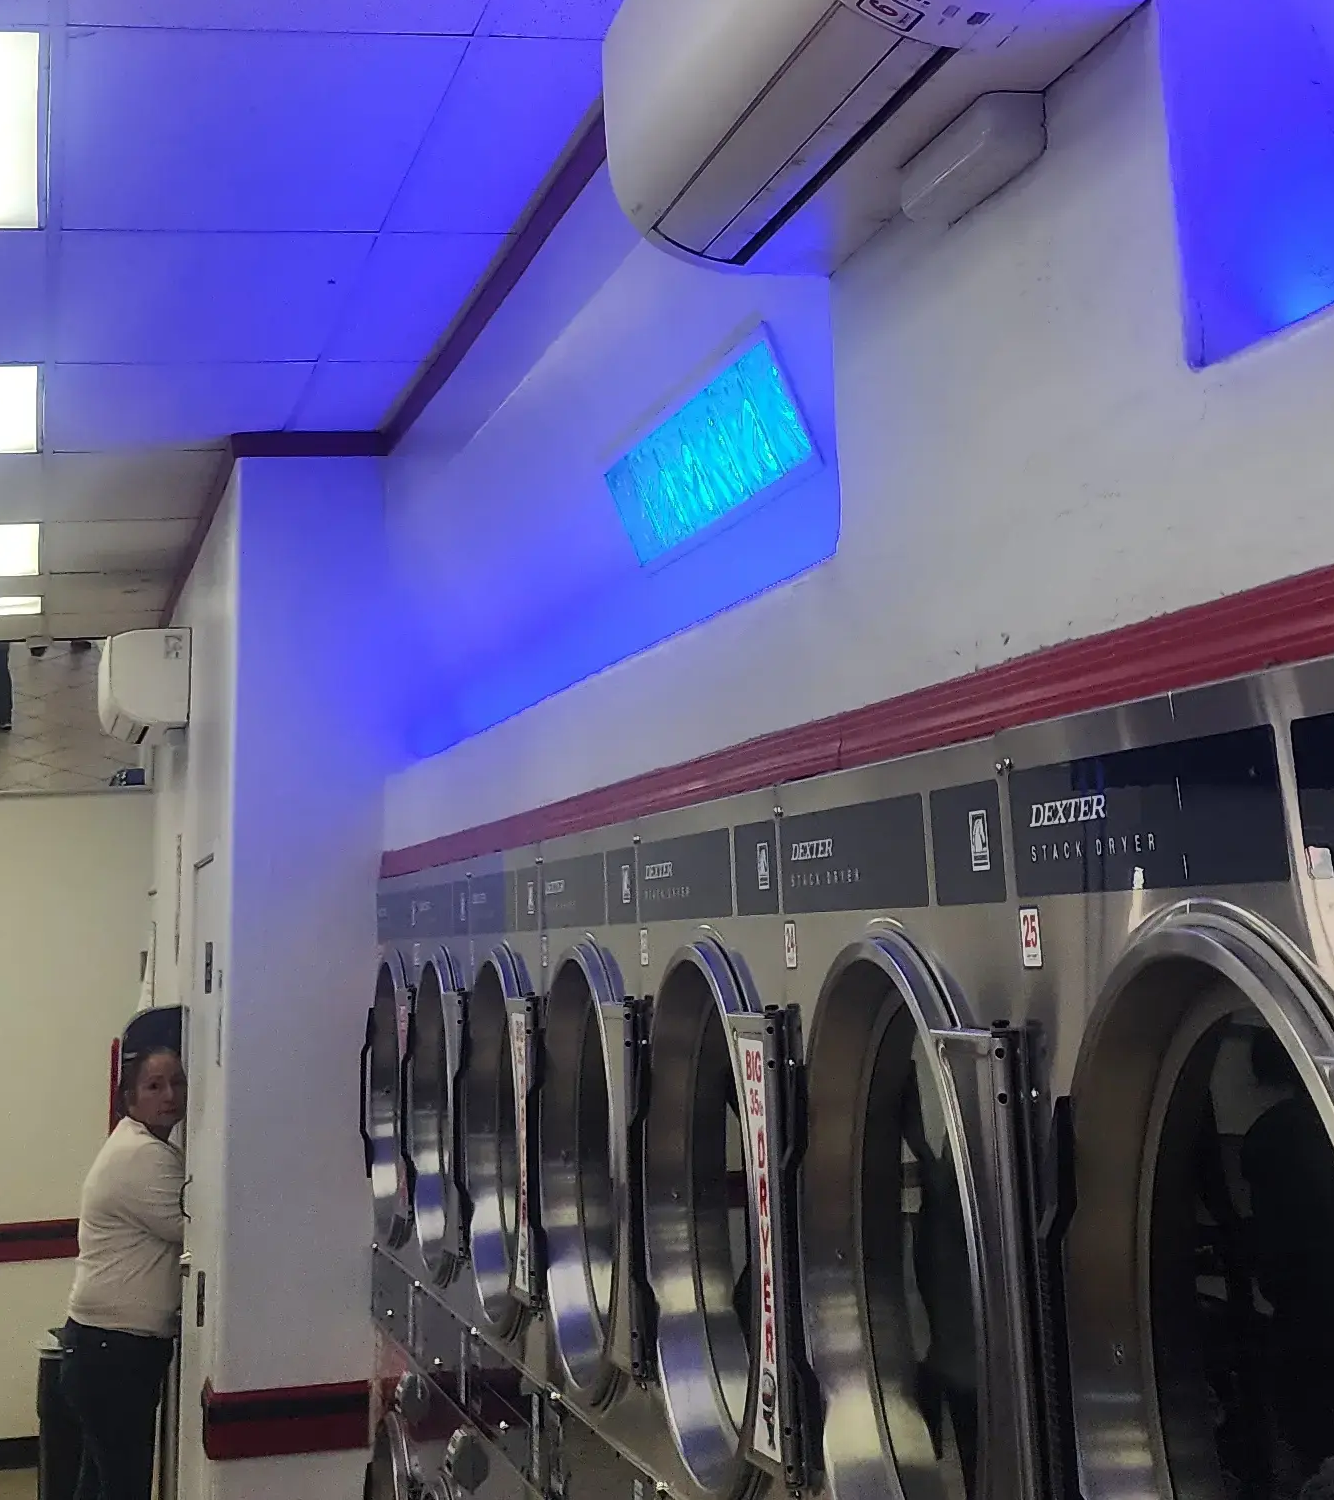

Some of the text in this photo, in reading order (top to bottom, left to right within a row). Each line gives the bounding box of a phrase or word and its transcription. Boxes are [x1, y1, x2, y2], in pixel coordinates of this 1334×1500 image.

[1029, 794, 1107, 829] DEXTER
[790, 838, 834, 862] DEXTER
[1031, 832, 1156, 863] STACK DRYER
[1022, 914, 1038, 949] 25
[746, 1049, 762, 1083] BIG
